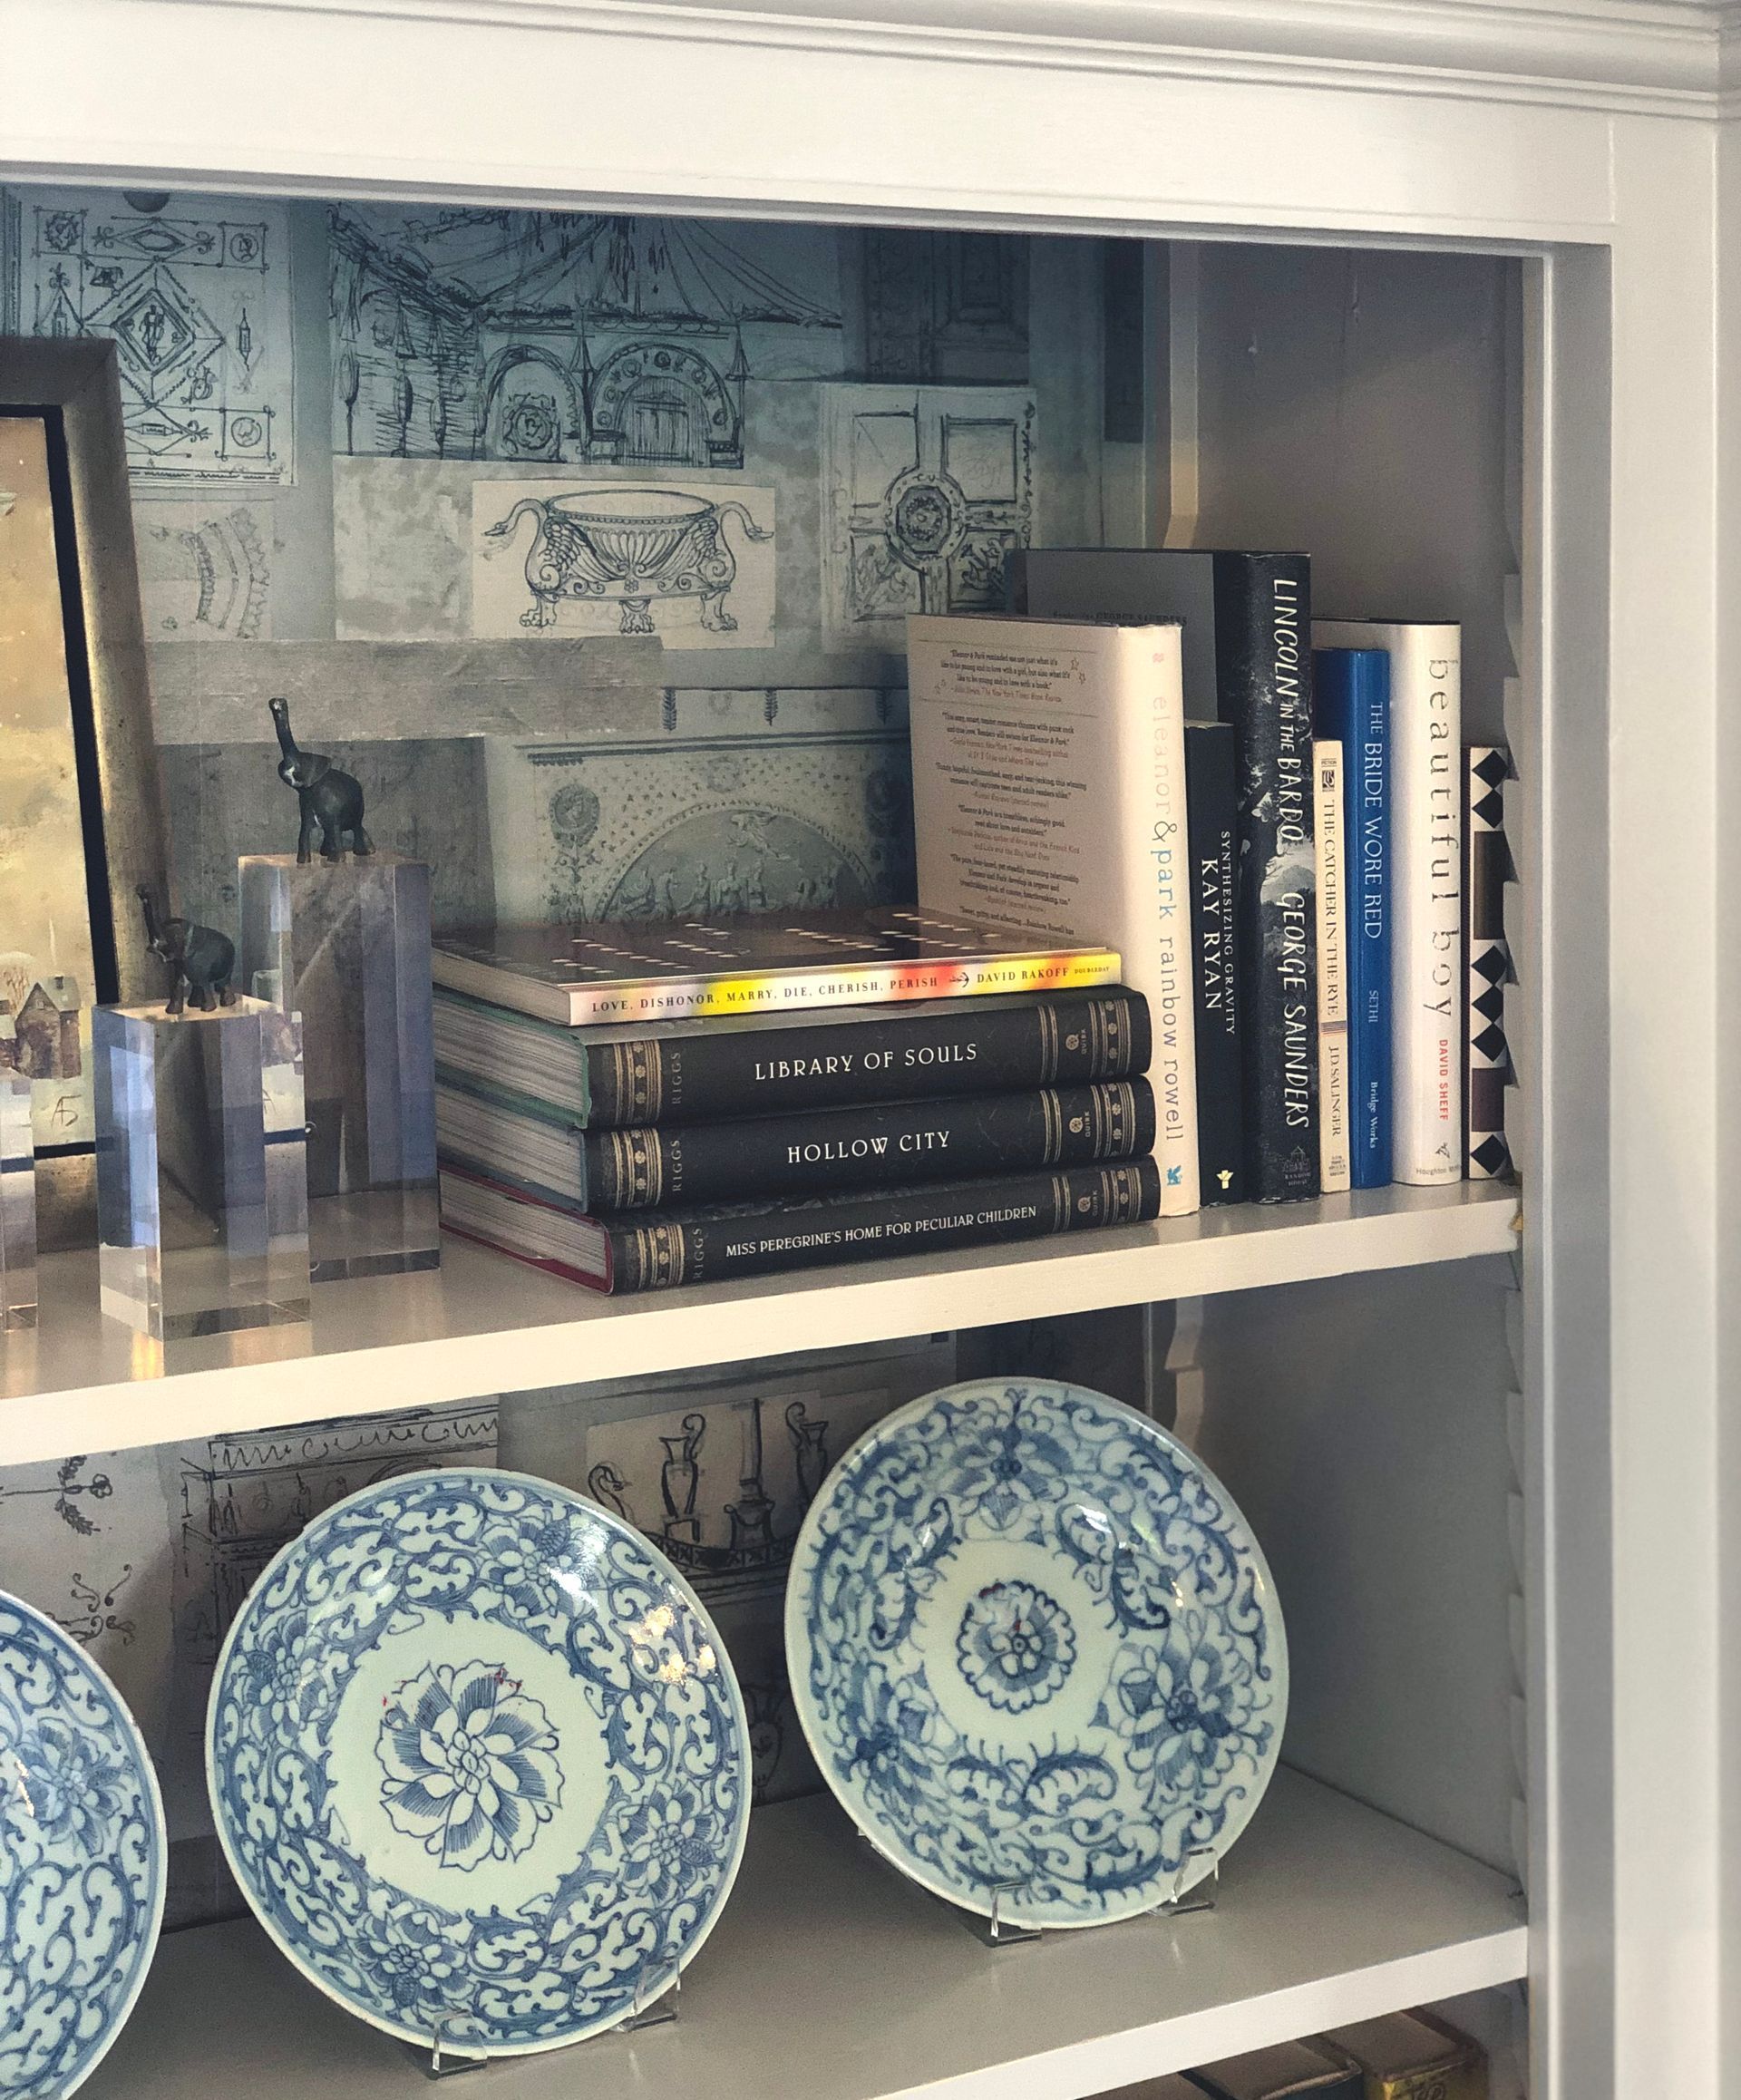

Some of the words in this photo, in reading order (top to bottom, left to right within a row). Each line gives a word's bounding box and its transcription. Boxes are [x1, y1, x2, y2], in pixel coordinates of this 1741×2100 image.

[1273, 579, 1299, 696] LINCOLN
[1279, 704, 1294, 718] IN
[1370, 702, 1383, 734] THE
[1153, 695, 1172, 814] eleanor
[1279, 724, 1295, 752] THE
[1277, 757, 1304, 841] BARDO
[1364, 743, 1383, 808] BRIDE
[1428, 659, 1458, 902] beautiful
[1152, 821, 1178, 842] &
[1323, 799, 1336, 835] THE
[1364, 816, 1383, 886] WORE
[1150, 849, 1177, 919] park
[1201, 859, 1220, 916] KAY
[1221, 831, 1233, 956] SYNTHESIZING
[1324, 839, 1337, 917] CATCHER
[1276, 892, 1308, 990] GEORGE
[1326, 921, 1337, 939] IN
[1364, 893, 1383, 938] RED
[977, 971, 1016, 984] DAVID
[1022, 967, 1069, 980] RAKOFF
[1203, 931, 1222, 1008] RYAN
[1326, 941, 1338, 980] THE
[1423, 928, 1459, 1016] boy
[592, 1000, 634, 1012] LOVE,
[640, 994, 720, 1009] DISHONOR,
[726, 989, 777, 1002] MARRY,
[784, 987, 812, 998] DIE,
[890, 977, 939, 990] PERISH
[1160, 937, 1181, 1047] rainbow
[1224, 963, 1235, 1035] GRAVITY
[1327, 982, 1339, 1016] RYE
[1368, 990, 1379, 1023] SETHI
[671, 1052, 683, 1105] RIGGS
[755, 1055, 854, 1081] LIBRARY
[864, 1051, 894, 1070] OF
[905, 1043, 977, 1066] SOULS
[1283, 1004, 1308, 1128] SAUNDERS
[1438, 1039, 1449, 1076] DAVID
[1163, 1060, 1184, 1141] rowell
[1367, 1082, 1378, 1113] Bridge
[1438, 1083, 1449, 1121] SHEFF
[787, 1136, 889, 1163] HOLLOW
[900, 1131, 950, 1152] CITY
[1369, 1116, 1378, 1149] Works
[671, 1139, 683, 1192] RIGGS
[693, 1227, 705, 1279] RIGGS
[726, 1241, 756, 1258] MISS
[760, 1230, 841, 1252] PEREGRINE'S
[845, 1225, 882, 1241] HOME
[886, 1221, 912, 1237] FOR
[915, 1213, 975, 1233] PECULIAR
[977, 1205, 1036, 1224] CHILDREN
